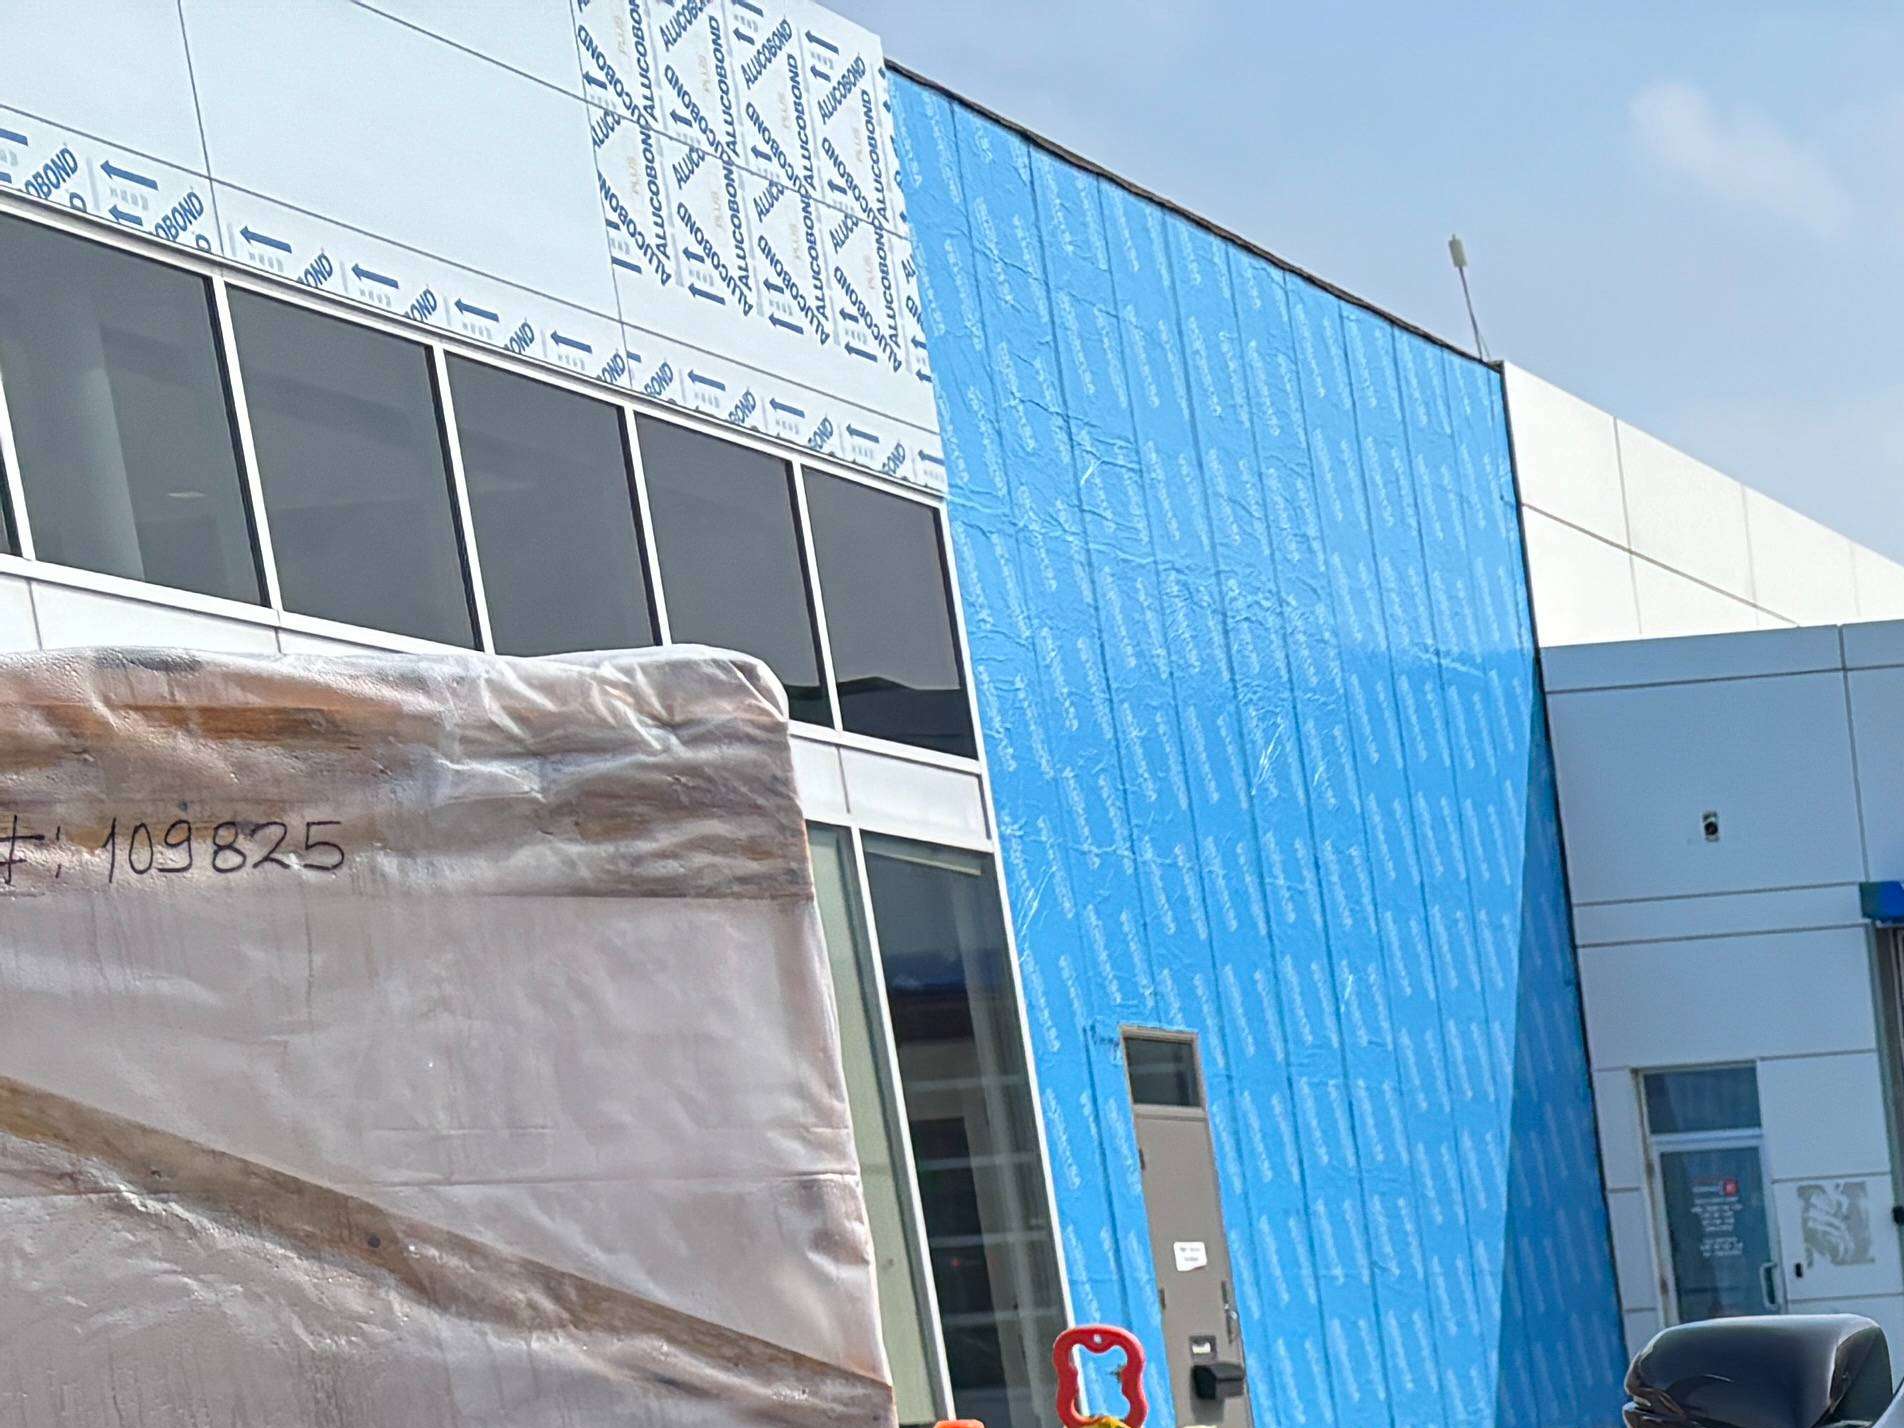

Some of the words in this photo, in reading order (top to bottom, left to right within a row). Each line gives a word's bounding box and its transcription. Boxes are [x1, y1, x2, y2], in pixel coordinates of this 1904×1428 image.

[708, 15, 740, 158] ALUCOBOND
[741, 18, 792, 90] ALUCOBOND
[817, 55, 866, 125] ALUCOBOND
[787, 53, 816, 191] ALUCOBOND
[861, 89, 889, 222] ALUCOBOND
[677, 202, 753, 316] ALUCOBOND
[719, 150, 752, 291] ALUCOBOND
[800, 184, 829, 321] ALUCOBOND
[872, 215, 901, 349] ALUCOBOND
[757, 235, 830, 345] ALUCOBOND
[834, 266, 902, 372] ALUCOBOND
[101, 816, 345, 884] 109825
